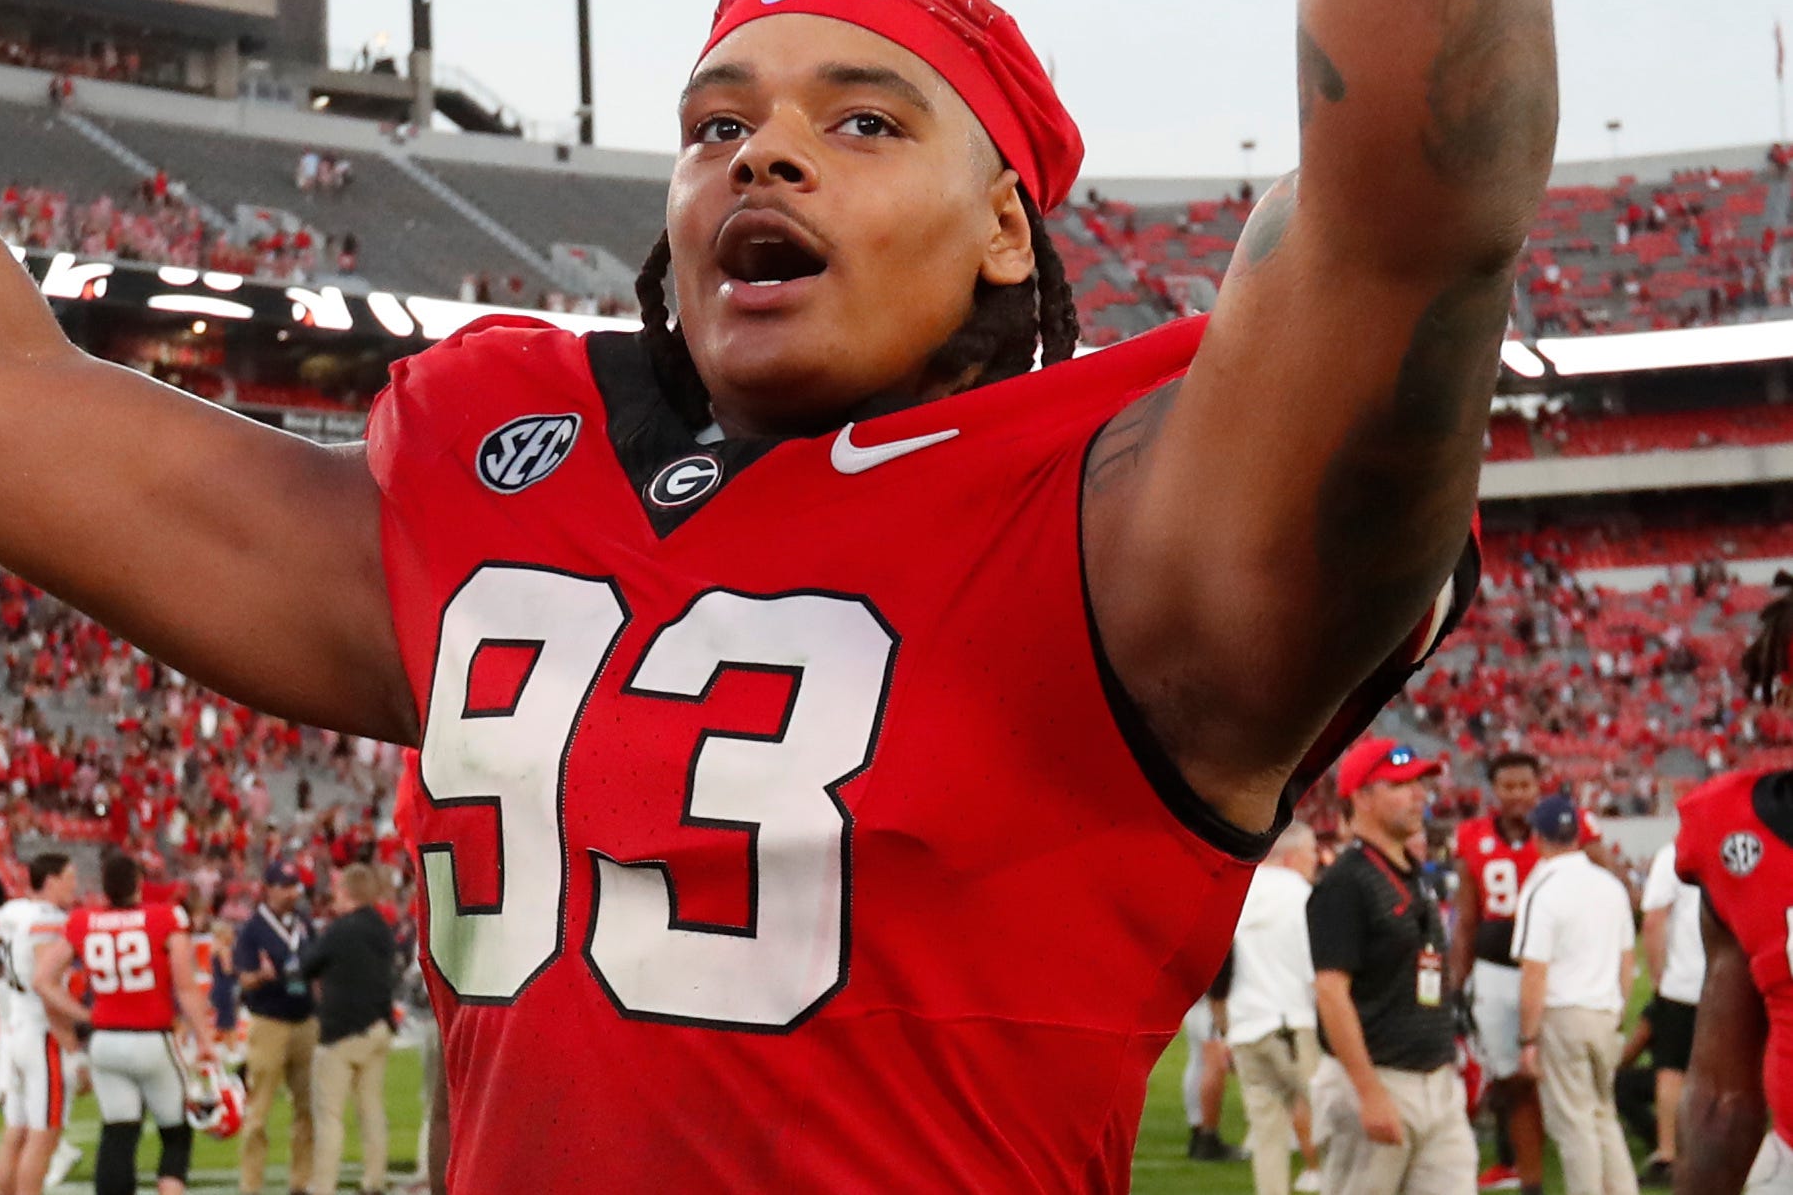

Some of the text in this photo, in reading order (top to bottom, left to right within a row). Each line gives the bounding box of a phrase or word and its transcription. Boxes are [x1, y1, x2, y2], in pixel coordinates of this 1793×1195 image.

[482, 417, 574, 486] SEC
[650, 456, 719, 506] G
[418, 561, 901, 1034] 93
[1721, 832, 1763, 876] SEC
[84, 931, 156, 994] 92
